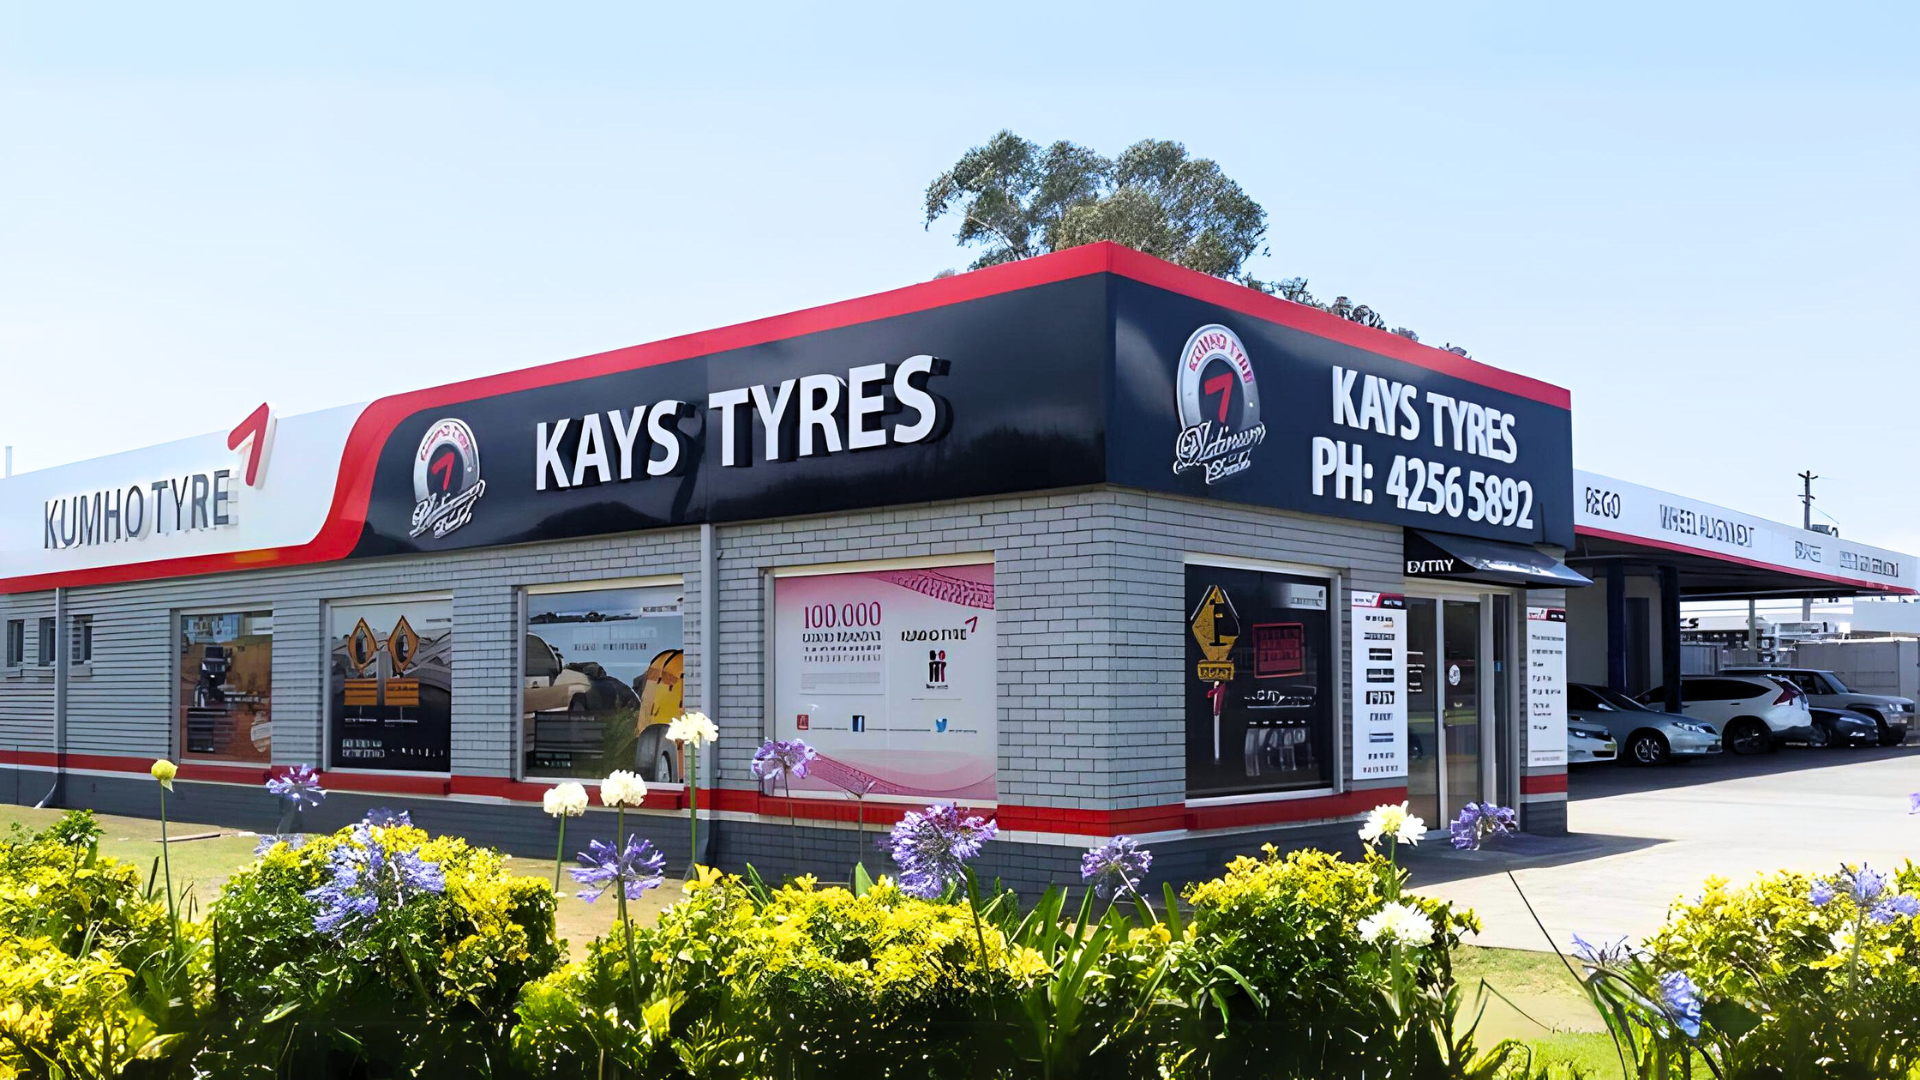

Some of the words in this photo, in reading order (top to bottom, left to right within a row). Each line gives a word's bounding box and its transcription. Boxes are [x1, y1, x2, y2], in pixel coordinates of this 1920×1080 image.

[536, 399, 684, 491] KAYS
[708, 354, 940, 467] TYRES
[1332, 365, 1420, 441] KAYS
[1427, 391, 1518, 464] TYRES
[44, 485, 145, 549] KUMHO
[151, 469, 231, 534] TYRE
[1312, 436, 1374, 505] PH:
[1386, 455, 1464, 518] 4256
[1467, 470, 1534, 530] 5892
